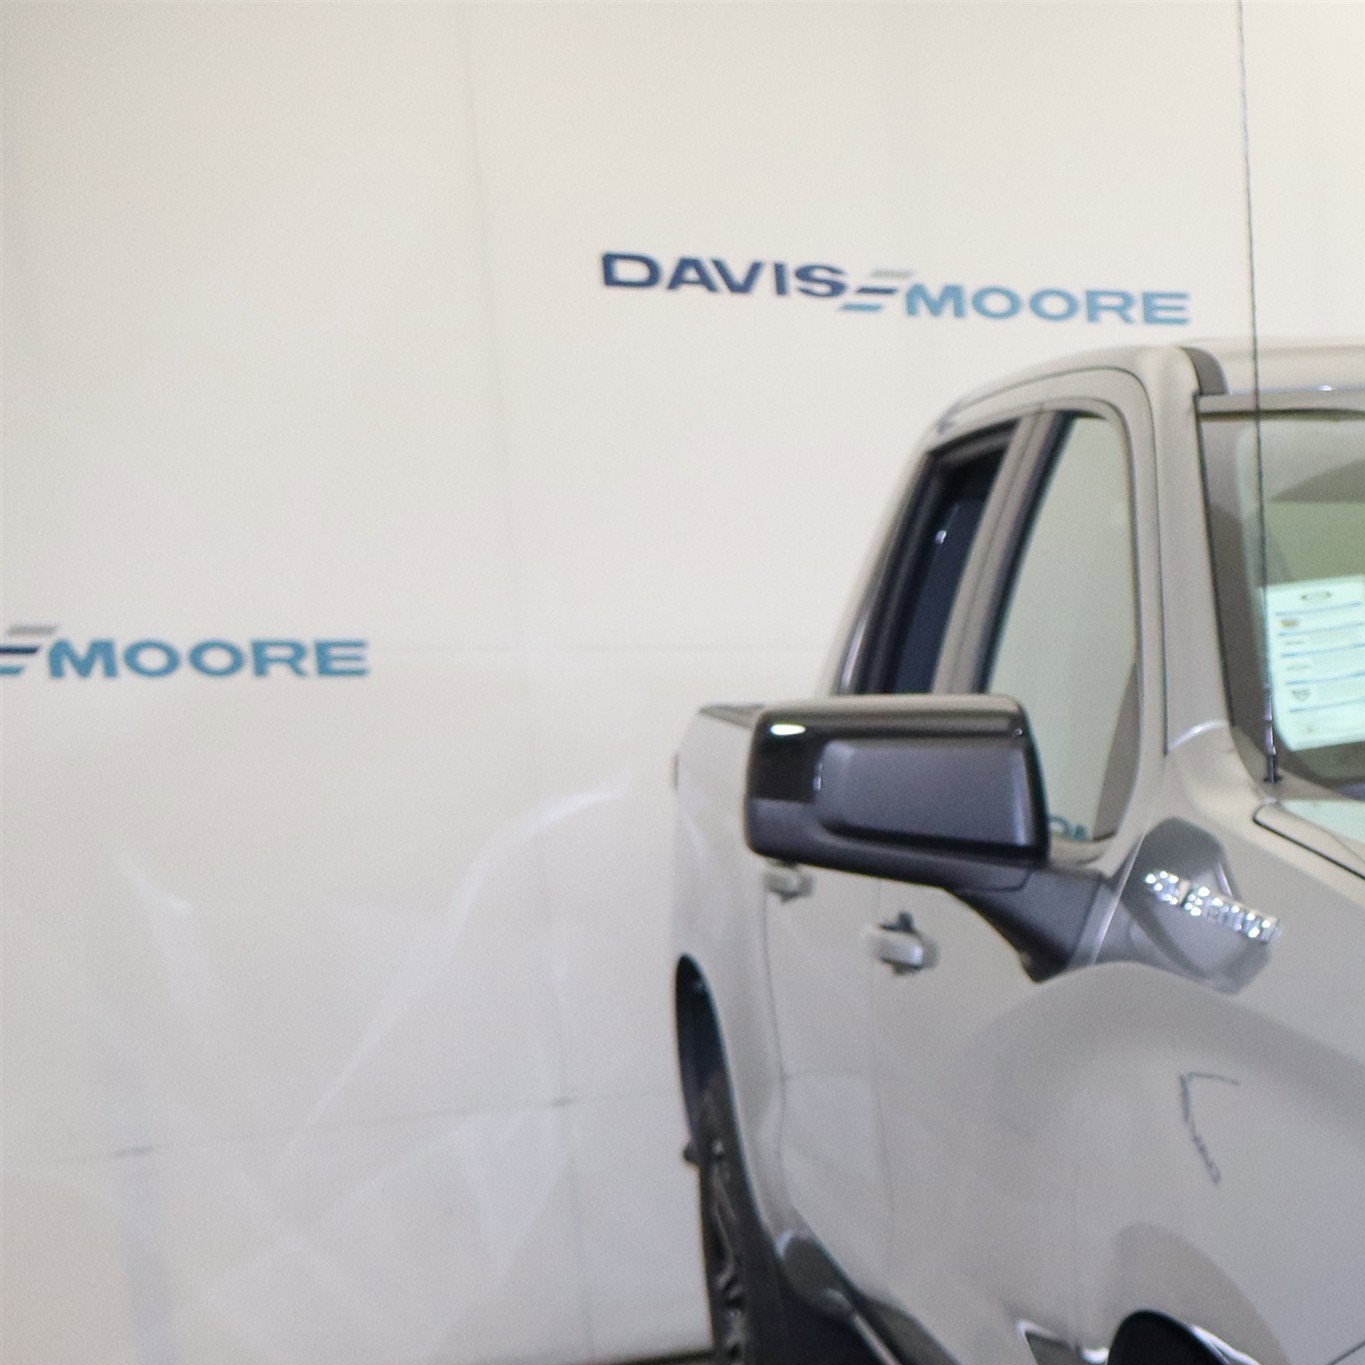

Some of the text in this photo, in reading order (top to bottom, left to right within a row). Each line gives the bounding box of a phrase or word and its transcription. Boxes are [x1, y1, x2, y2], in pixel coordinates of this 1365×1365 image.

[602, 252, 1191, 325] DAVIS MOORE
[49, 639, 370, 678] MOORE
